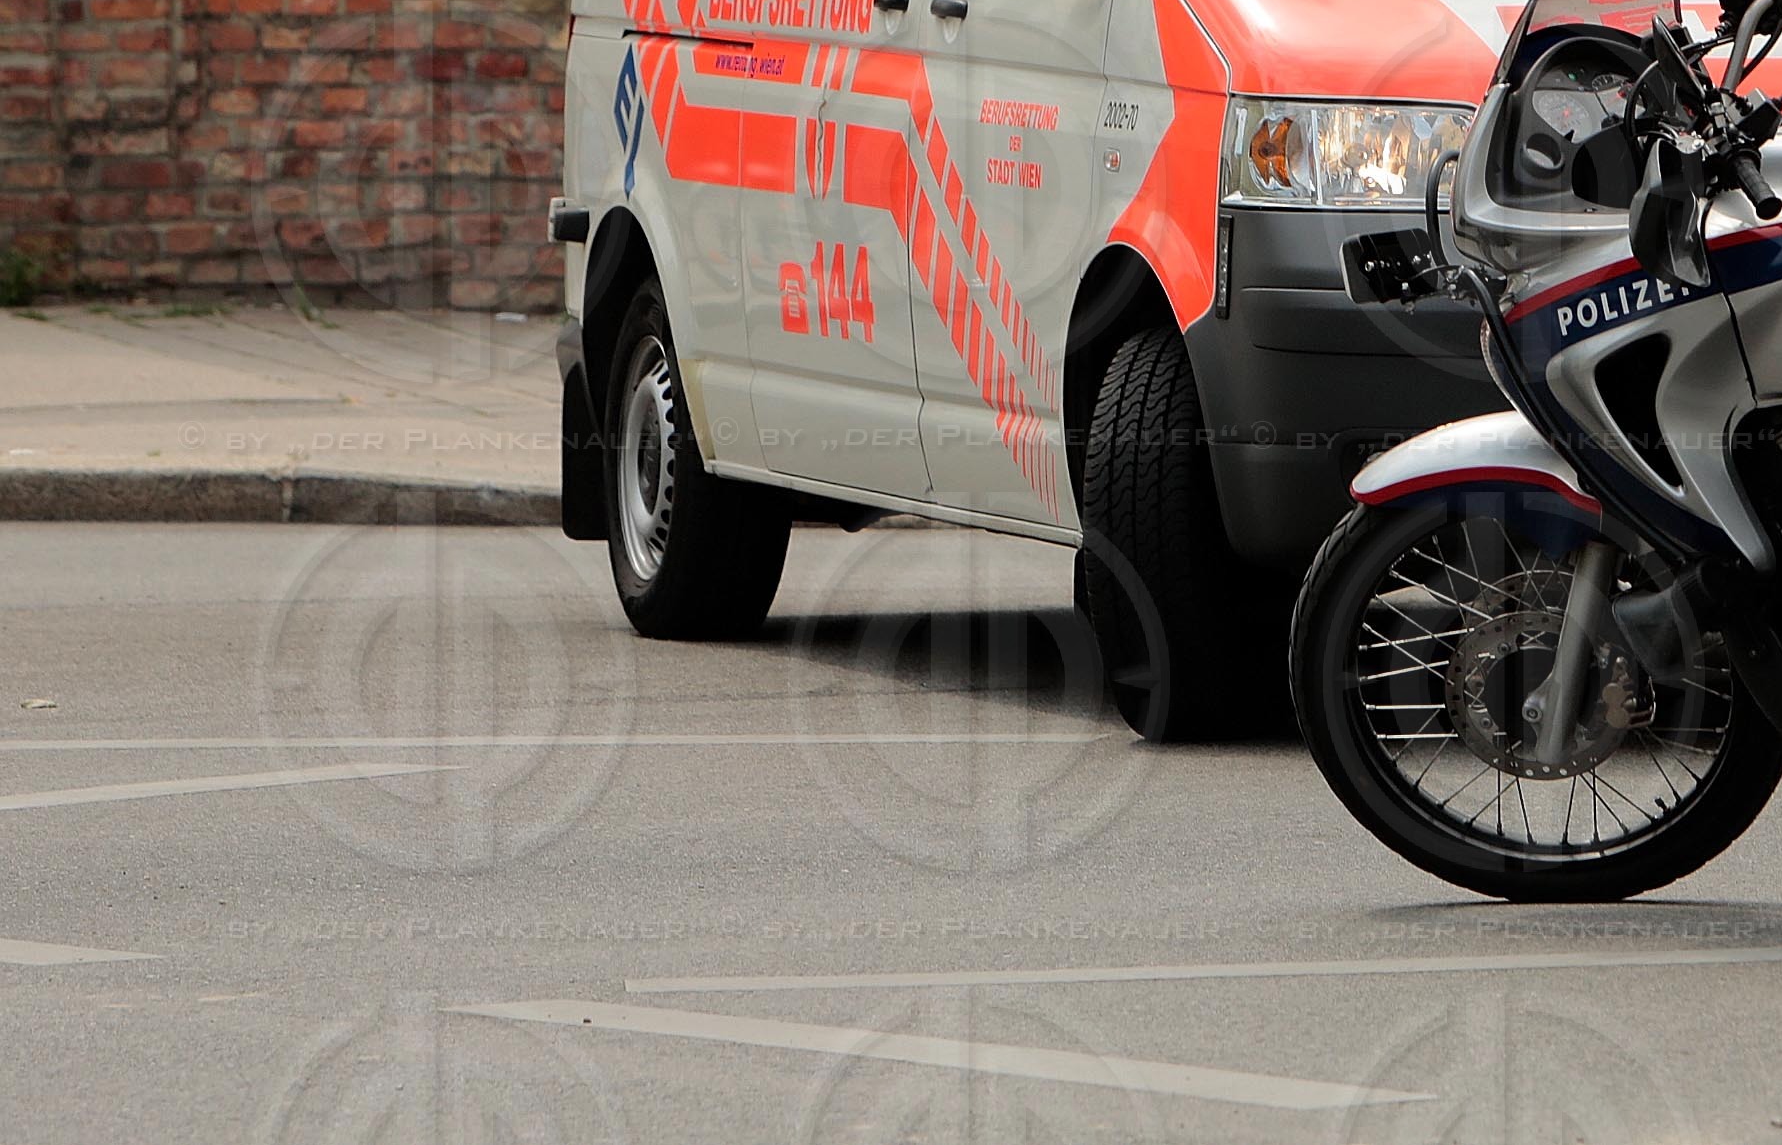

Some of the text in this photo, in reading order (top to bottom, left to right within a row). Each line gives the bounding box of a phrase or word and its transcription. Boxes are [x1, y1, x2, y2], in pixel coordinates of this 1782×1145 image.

[979, 97, 1060, 132] BERUFSRETTUNG
[1103, 101, 1140, 132] 2002-70
[1009, 135, 1023, 152] DER
[985, 157, 1043, 190] STADT WIEN
[809, 238, 876, 344] 144
